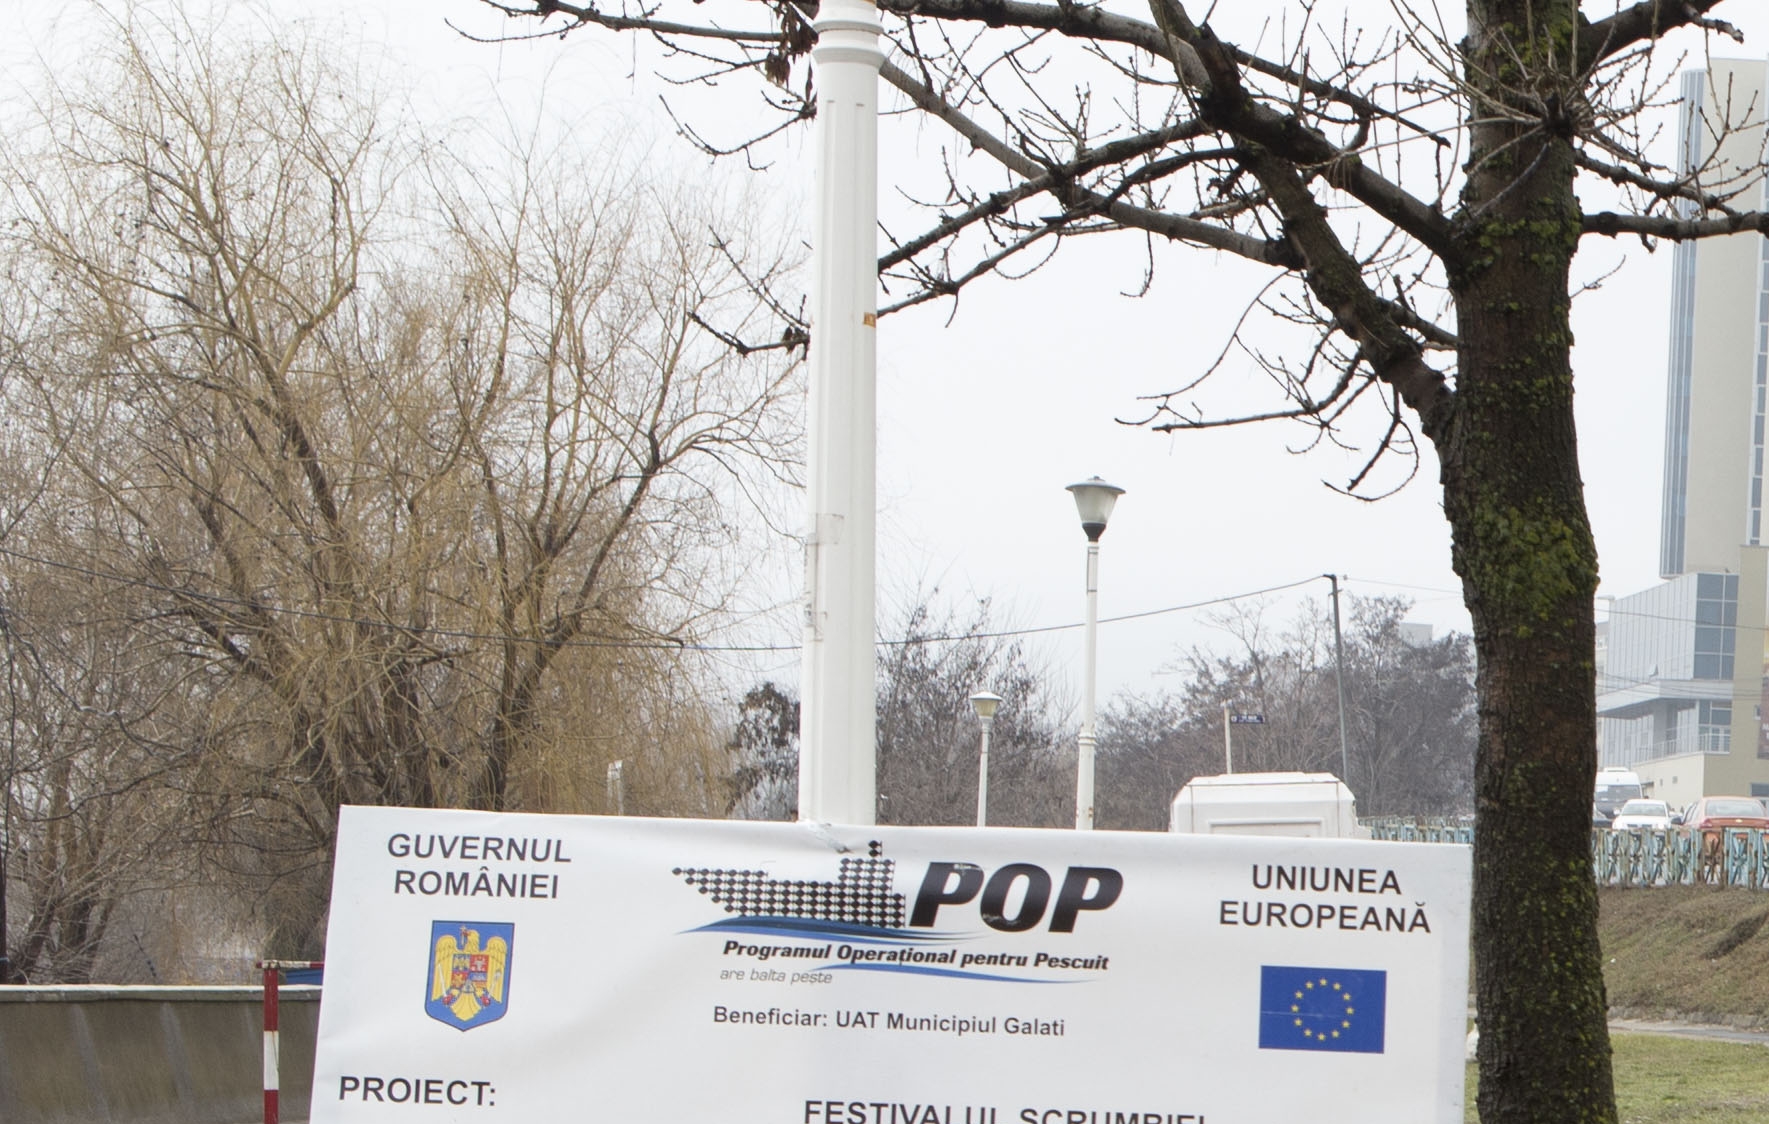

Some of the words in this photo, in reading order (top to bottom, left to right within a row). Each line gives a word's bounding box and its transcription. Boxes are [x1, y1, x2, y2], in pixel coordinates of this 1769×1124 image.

[387, 833, 572, 863] GUVERNUL
[394, 866, 559, 899] ROMÂNIEI
[1252, 864, 1402, 895] UNIUNEA
[909, 861, 1124, 934] POP
[1219, 901, 1431, 934] EUROPEANĂ
[723, 940, 832, 960] Programul
[960, 952, 1028, 968] pentru
[1034, 953, 1110, 970] Pescuit
[720, 969, 745, 981] are
[713, 1005, 828, 1027] Beneficiar:
[836, 1010, 880, 1029] UAT
[887, 1012, 996, 1036] Municipiul
[1004, 1017, 1065, 1036] Galati
[339, 1075, 496, 1107] PROIECT:
